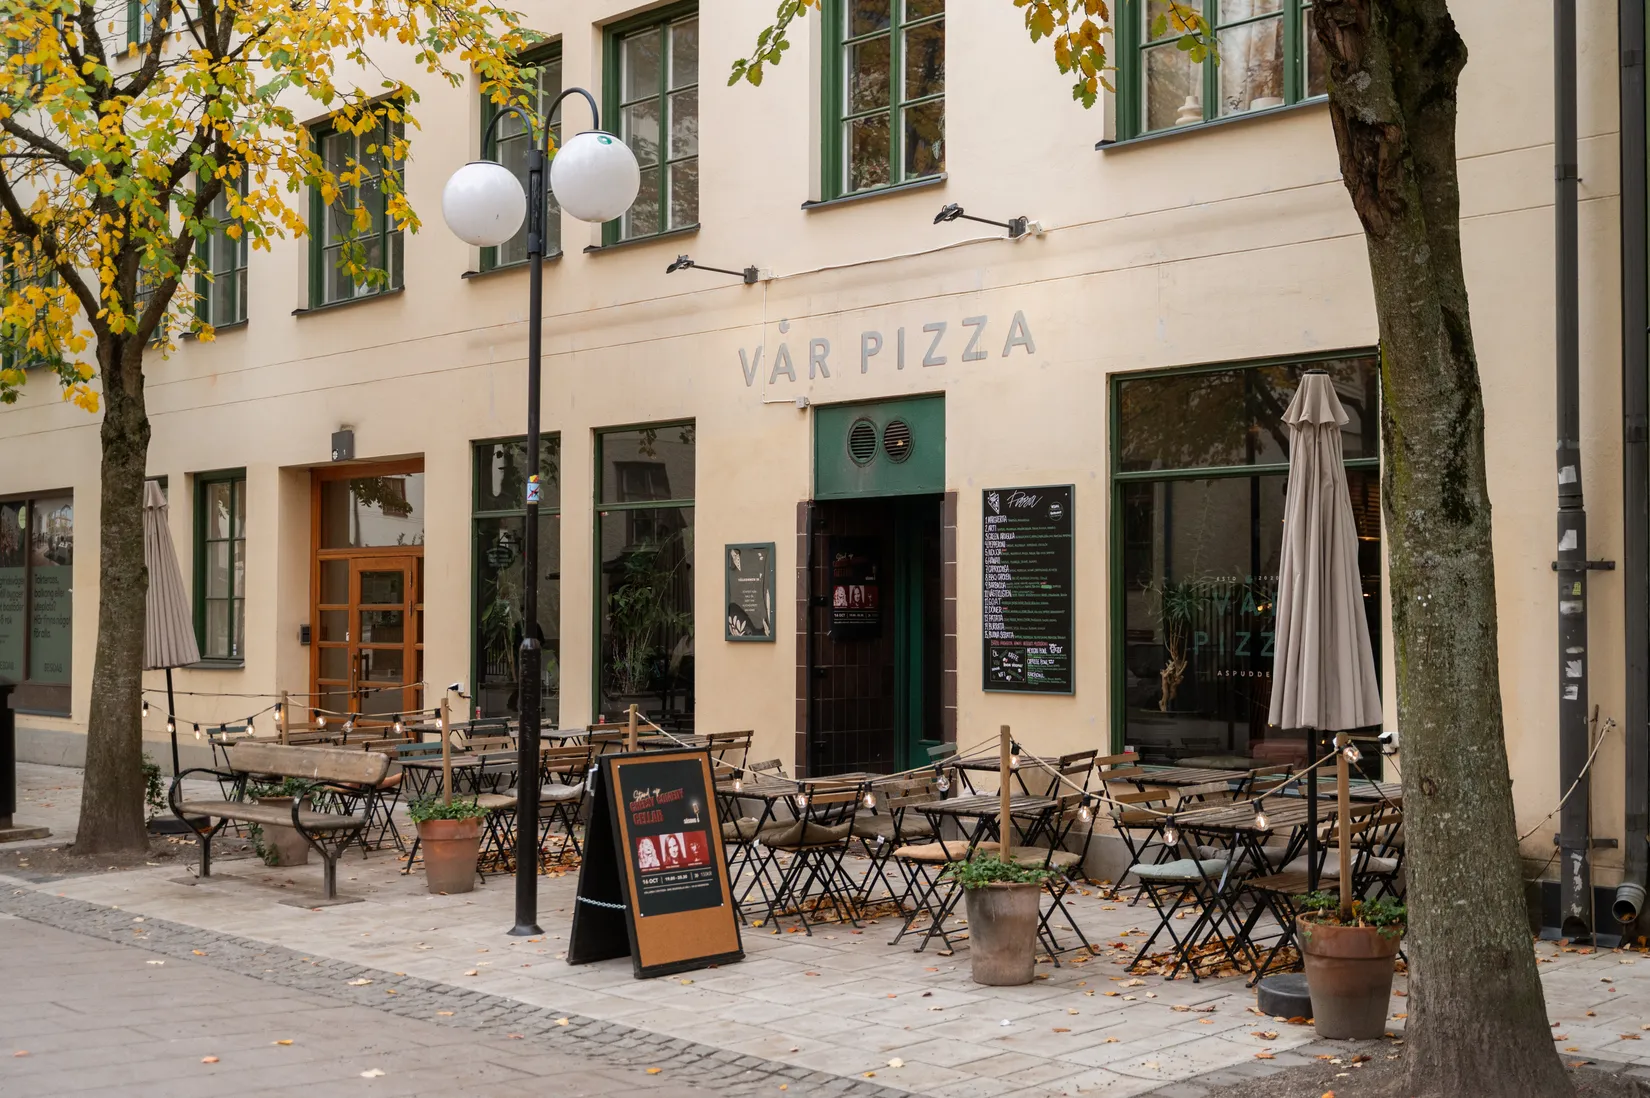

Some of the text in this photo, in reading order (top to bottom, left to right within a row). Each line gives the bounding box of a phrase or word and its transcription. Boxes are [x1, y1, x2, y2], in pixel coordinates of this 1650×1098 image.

[738, 310, 1036, 387] VÅR PIZZA
[1194, 631, 1275, 657] PIZZ
[633, 788, 650, 802] Stand
